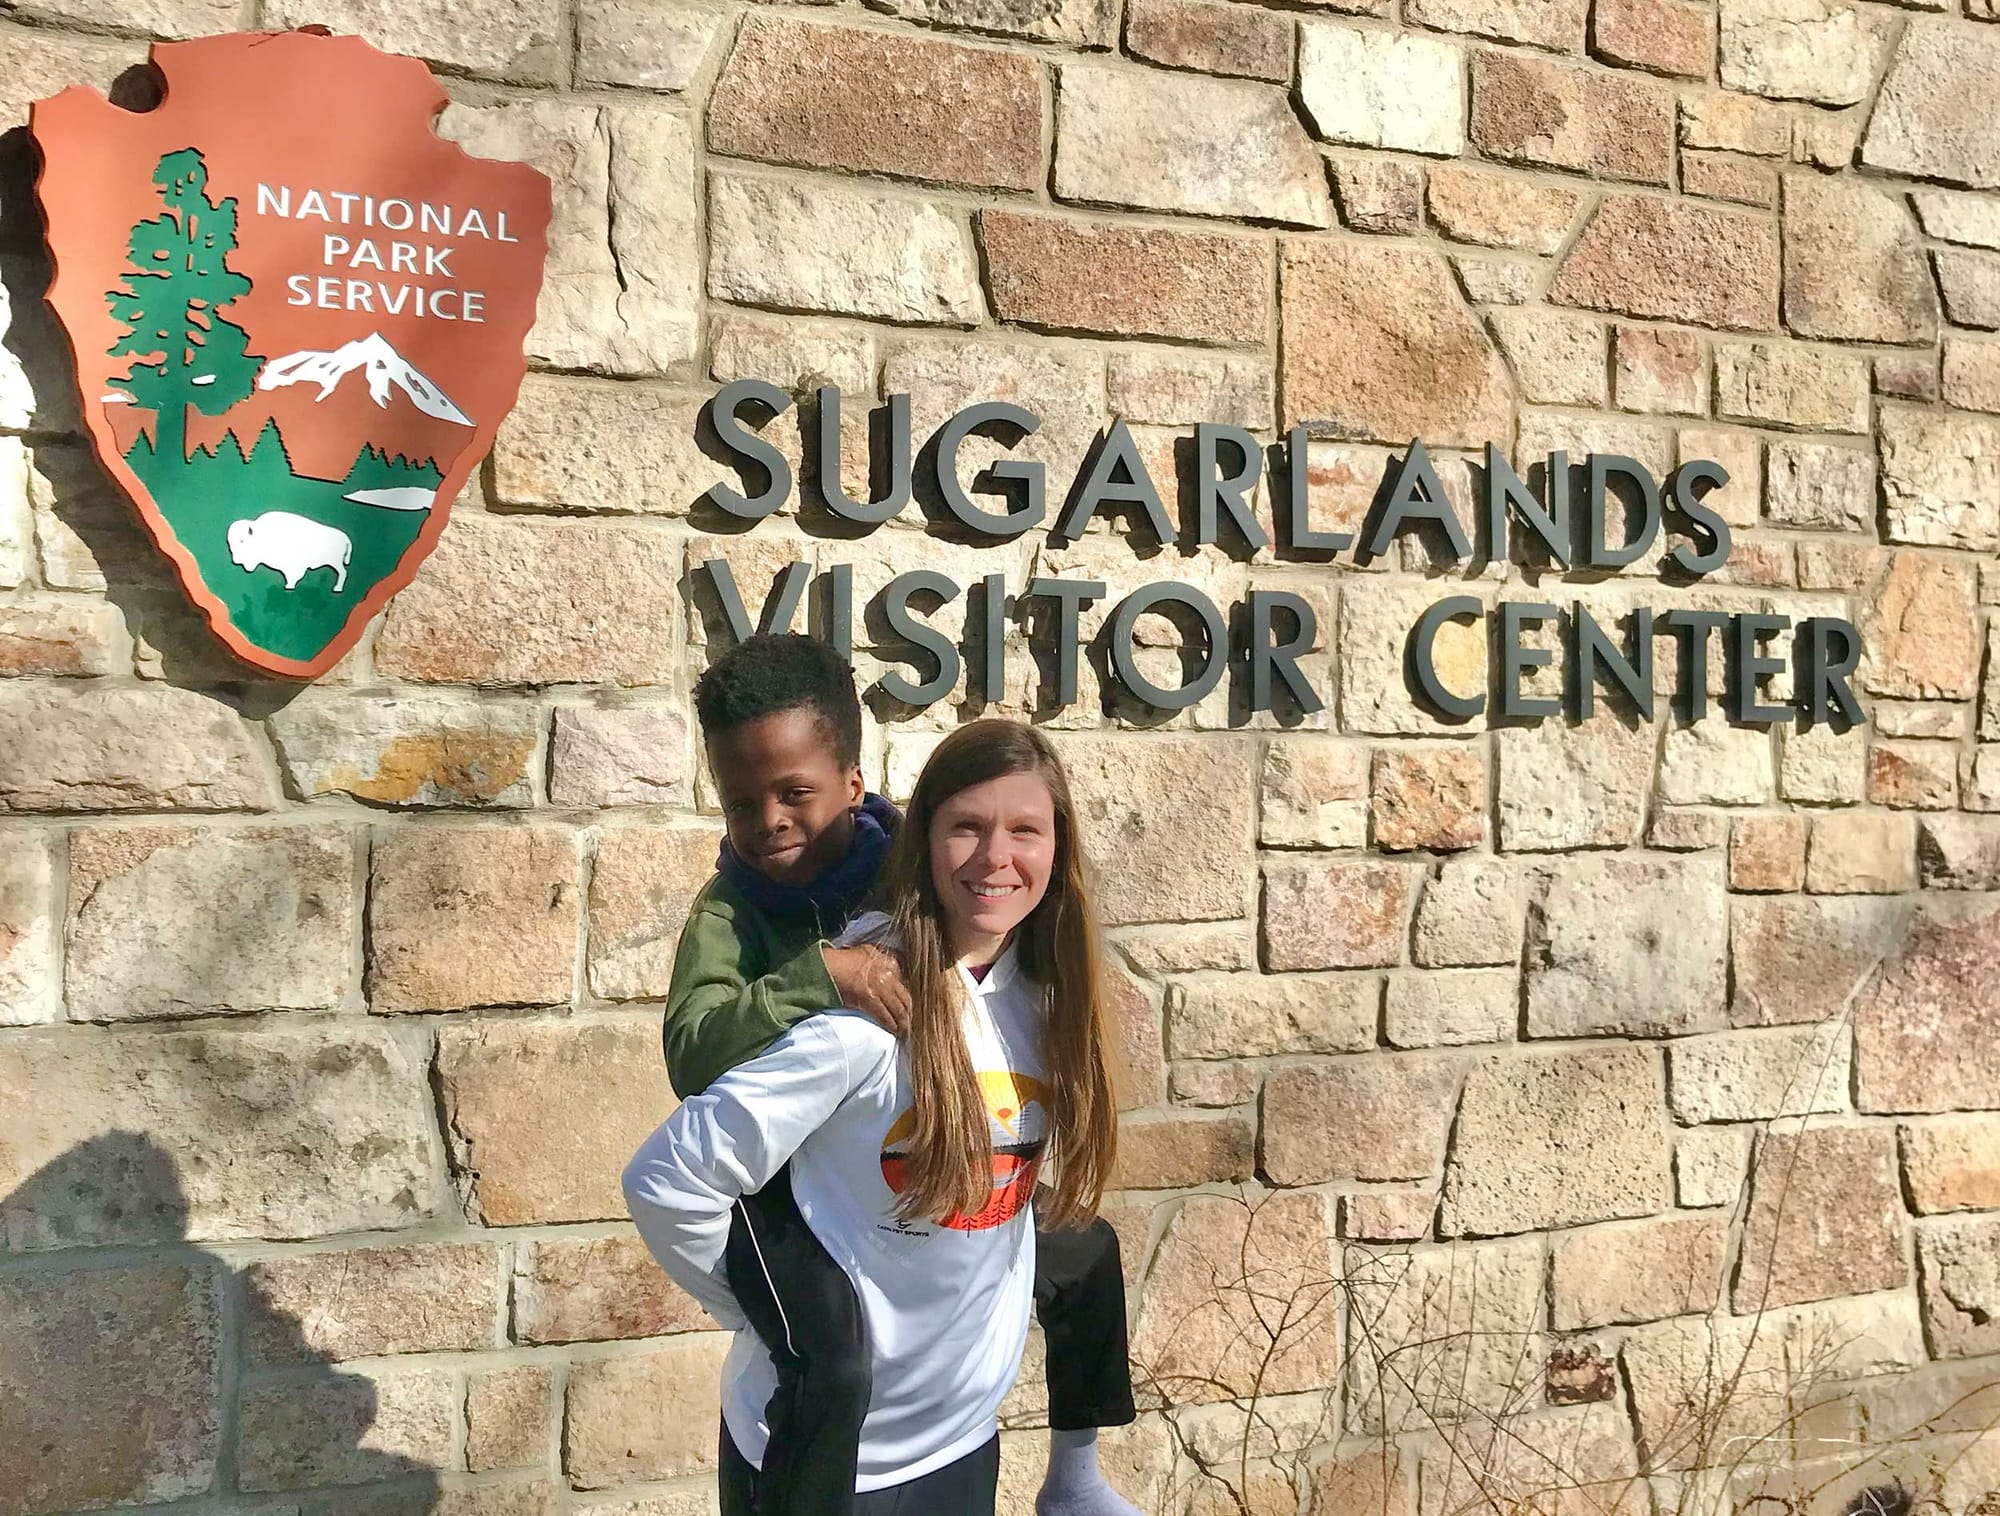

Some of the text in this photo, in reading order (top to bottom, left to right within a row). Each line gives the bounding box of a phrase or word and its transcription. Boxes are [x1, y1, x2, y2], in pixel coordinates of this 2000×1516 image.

[256, 182, 519, 243] NATIONAL
[323, 233, 456, 278] PARK
[287, 274, 486, 323] SERVICE
[704, 379, 1731, 573] SUGARLANDS
[703, 559, 1867, 726] VISITOR CENTER
